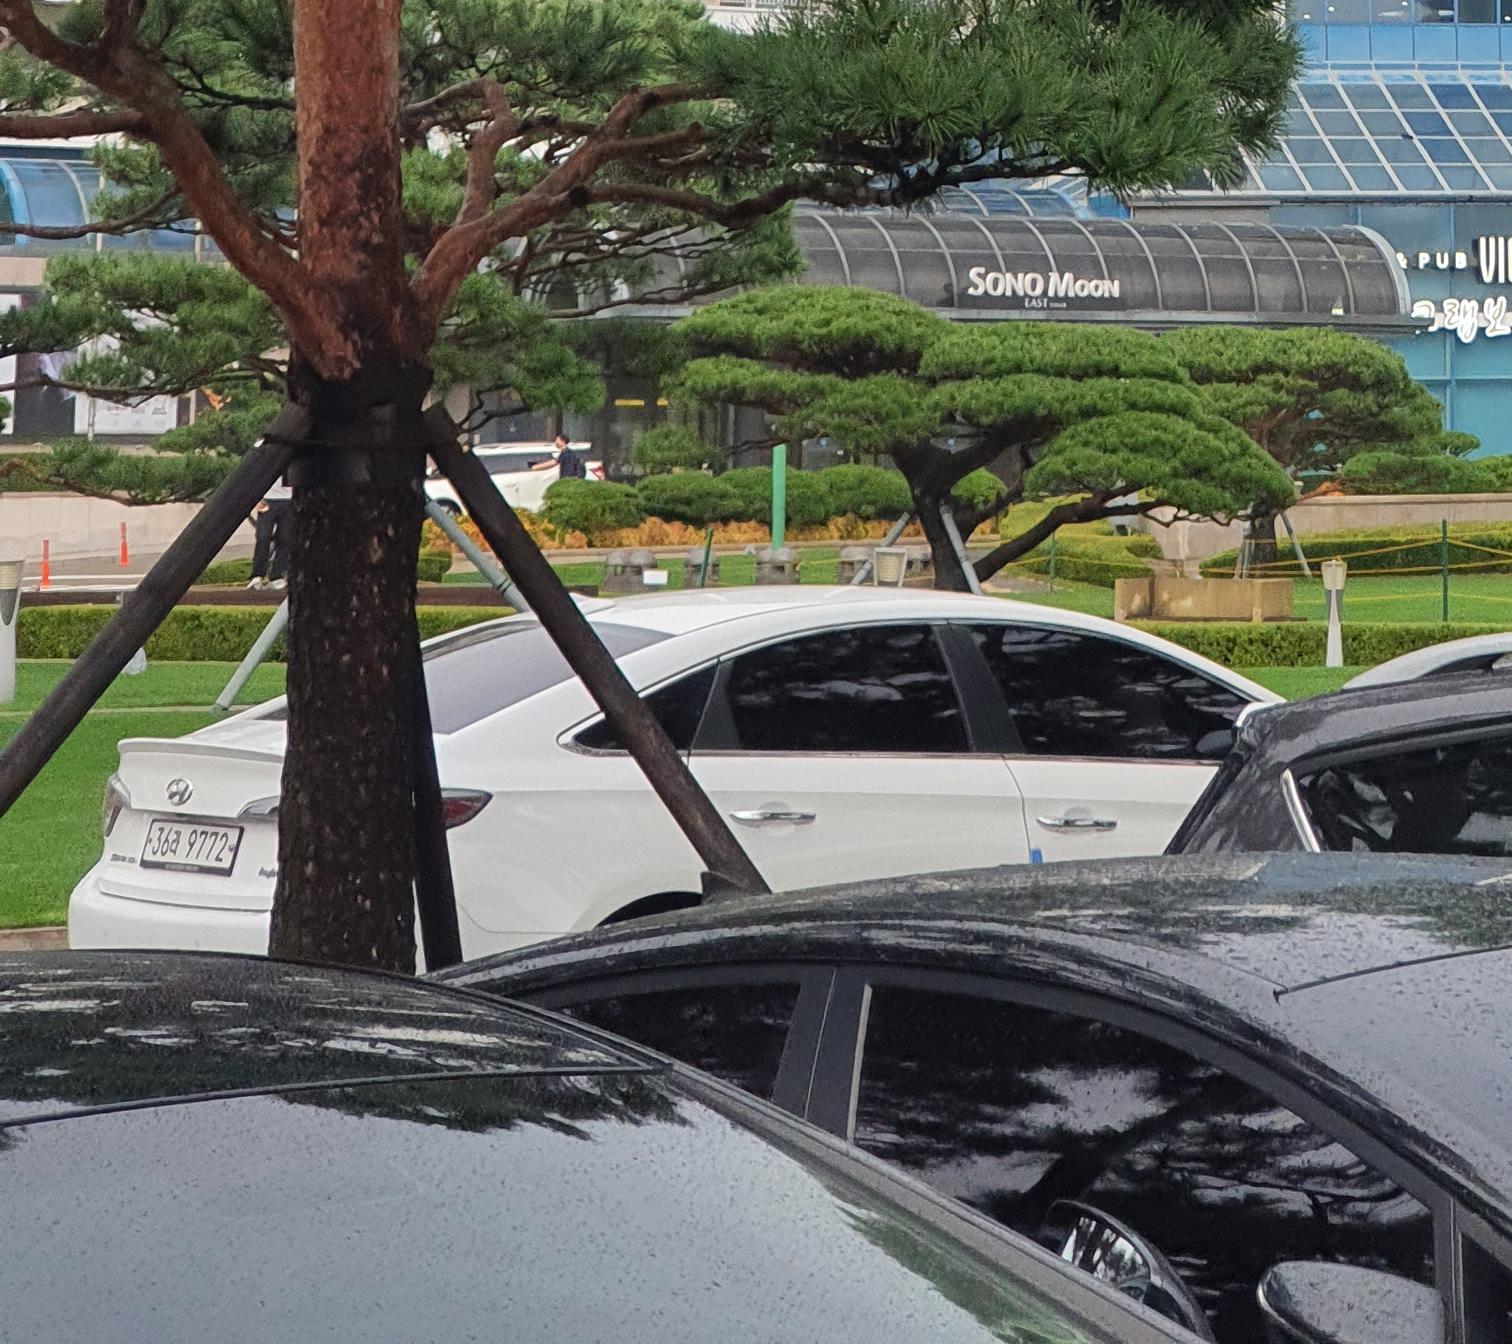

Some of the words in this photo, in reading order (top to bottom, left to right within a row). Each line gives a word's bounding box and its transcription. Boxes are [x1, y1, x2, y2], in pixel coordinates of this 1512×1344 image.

[1418, 251, 1468, 269] PUB
[967, 266, 1045, 297] SONO
[1024, 298, 1048, 308] EAST
[185, 828, 230, 862] 9772
